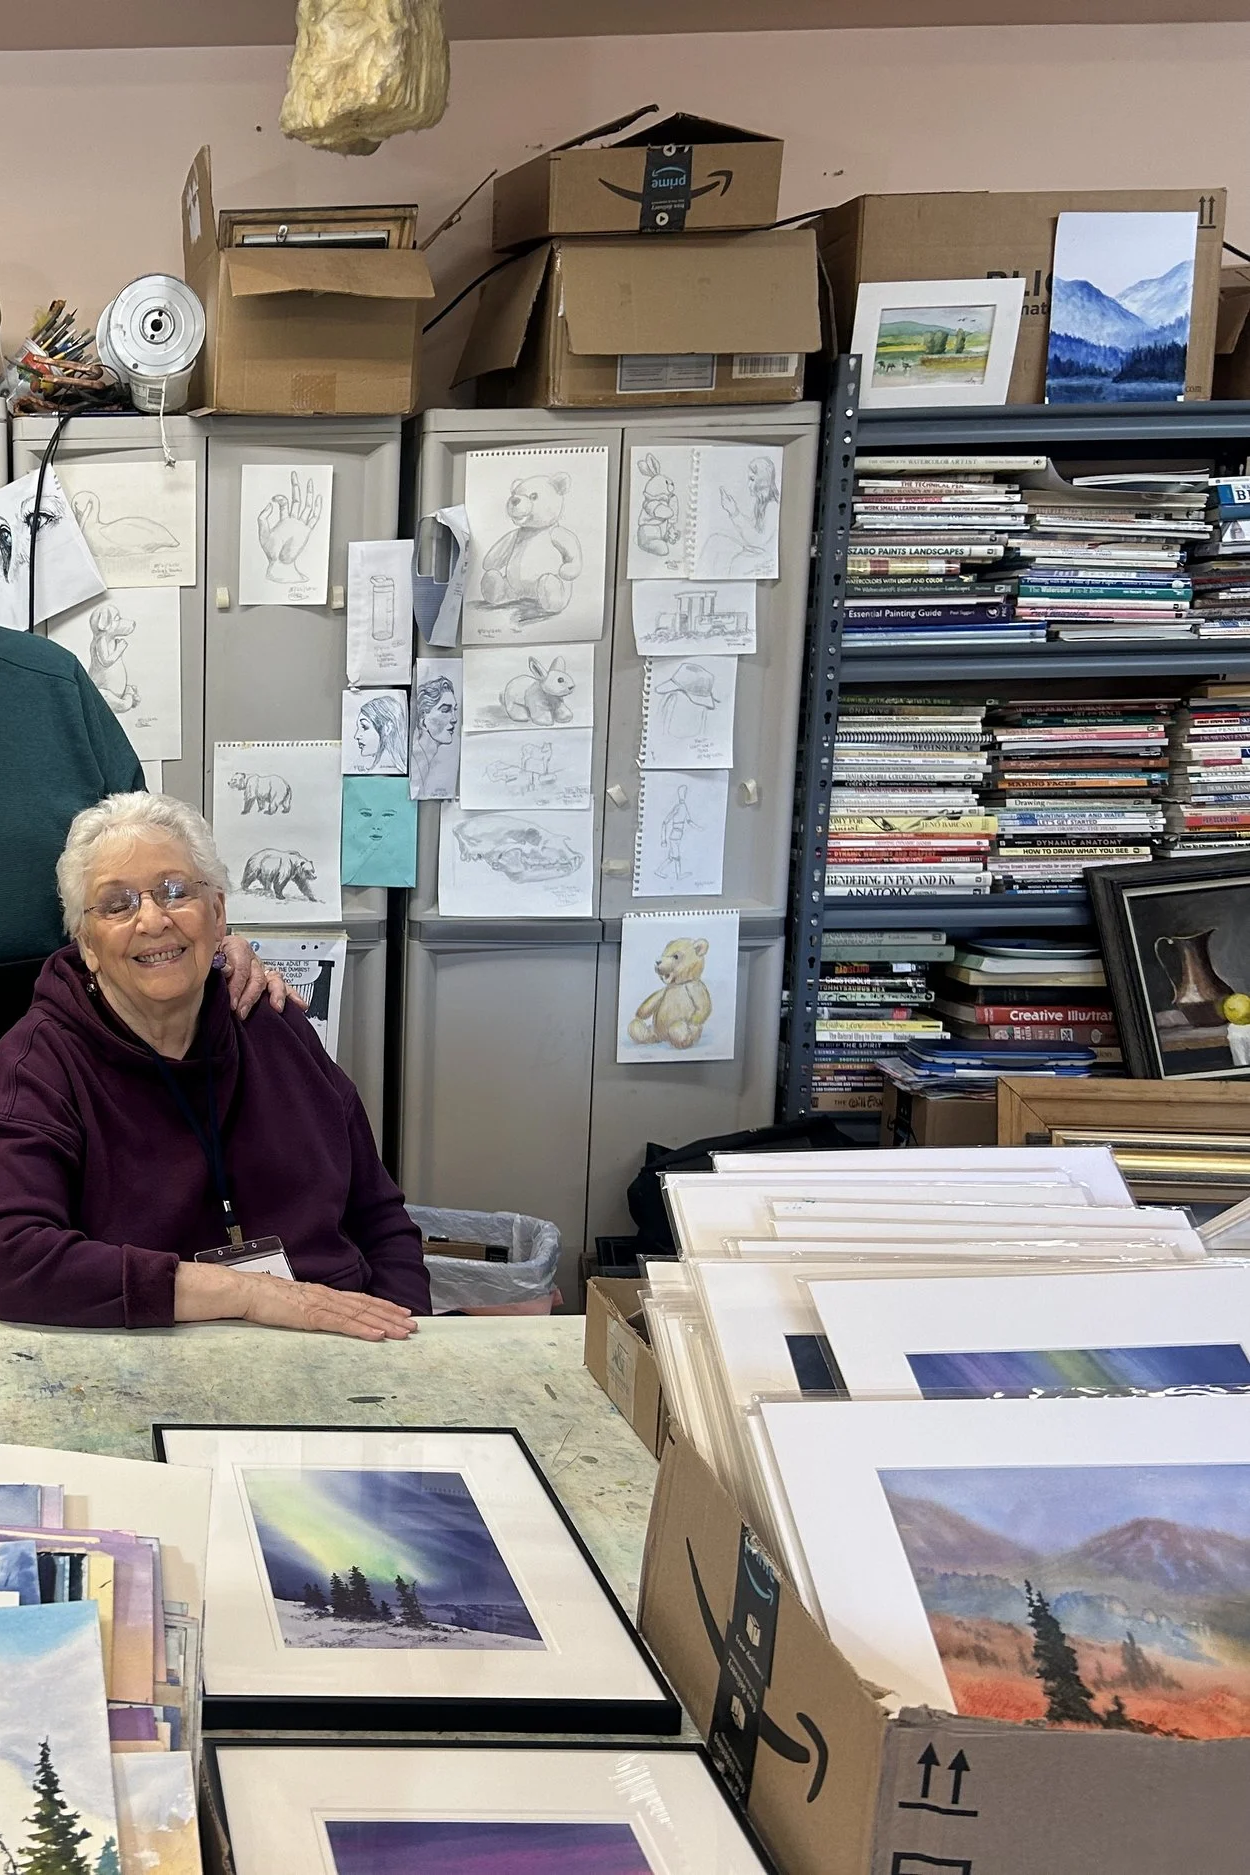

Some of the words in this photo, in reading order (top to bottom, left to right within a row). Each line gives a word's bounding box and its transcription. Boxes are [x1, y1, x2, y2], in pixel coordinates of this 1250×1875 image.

[651, 174, 686, 190] prime
[847, 548, 875, 556] SZABO
[878, 548, 906, 556] PAINTS
[909, 548, 964, 556] LANDSCAPES
[848, 610, 882, 618] Essential
[884, 609, 916, 619] Painting
[918, 609, 942, 617] Guide
[1014, 799, 1046, 807] Drawing
[827, 875, 881, 886] RENDERING
[884, 875, 893, 886] IN
[896, 875, 914, 886] PEN
[918, 875, 936, 886] AND
[938, 875, 956, 886] INK
[847, 887, 912, 896] ANATOMY
[835, 966, 848, 974] BAD
[825, 976, 871, 985] GHOSTOPOLIS
[819, 984, 870, 992] TOMMYSAURUS
[1009, 1009, 1063, 1021] Creative
[1068, 1010, 1113, 1021] Illustrat
